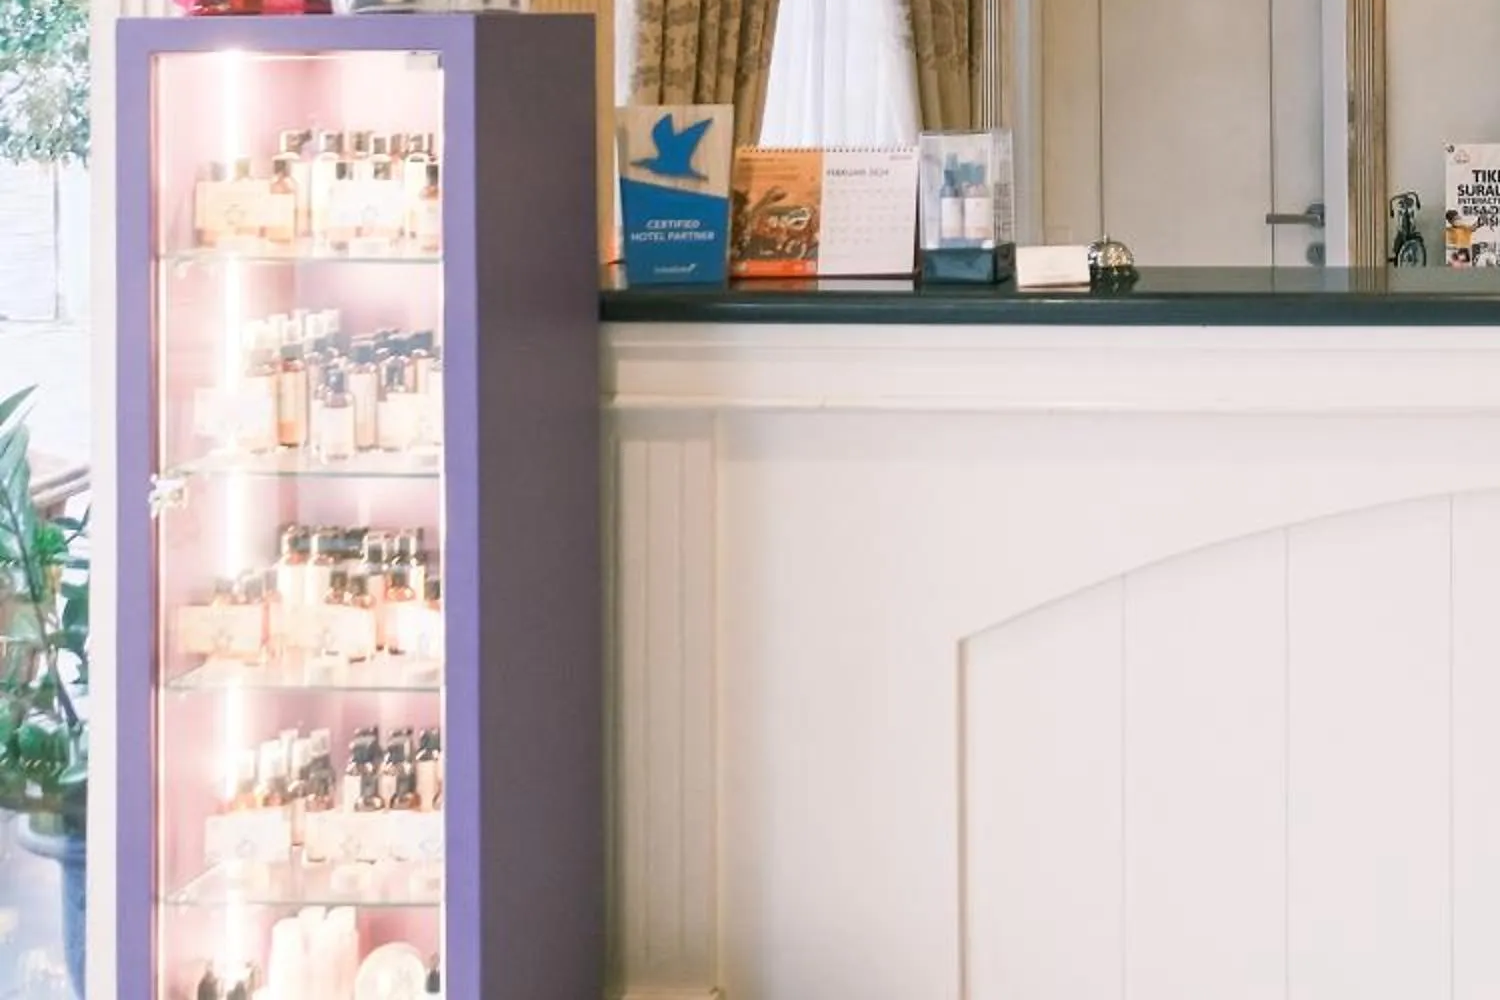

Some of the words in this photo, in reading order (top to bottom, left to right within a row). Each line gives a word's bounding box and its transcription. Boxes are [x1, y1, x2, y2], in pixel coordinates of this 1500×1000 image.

[1463, 206, 1488, 215] BISA
[646, 219, 701, 230] CERTIFIED
[630, 231, 665, 242] HOTEL
[667, 230, 716, 241] PARTNER
